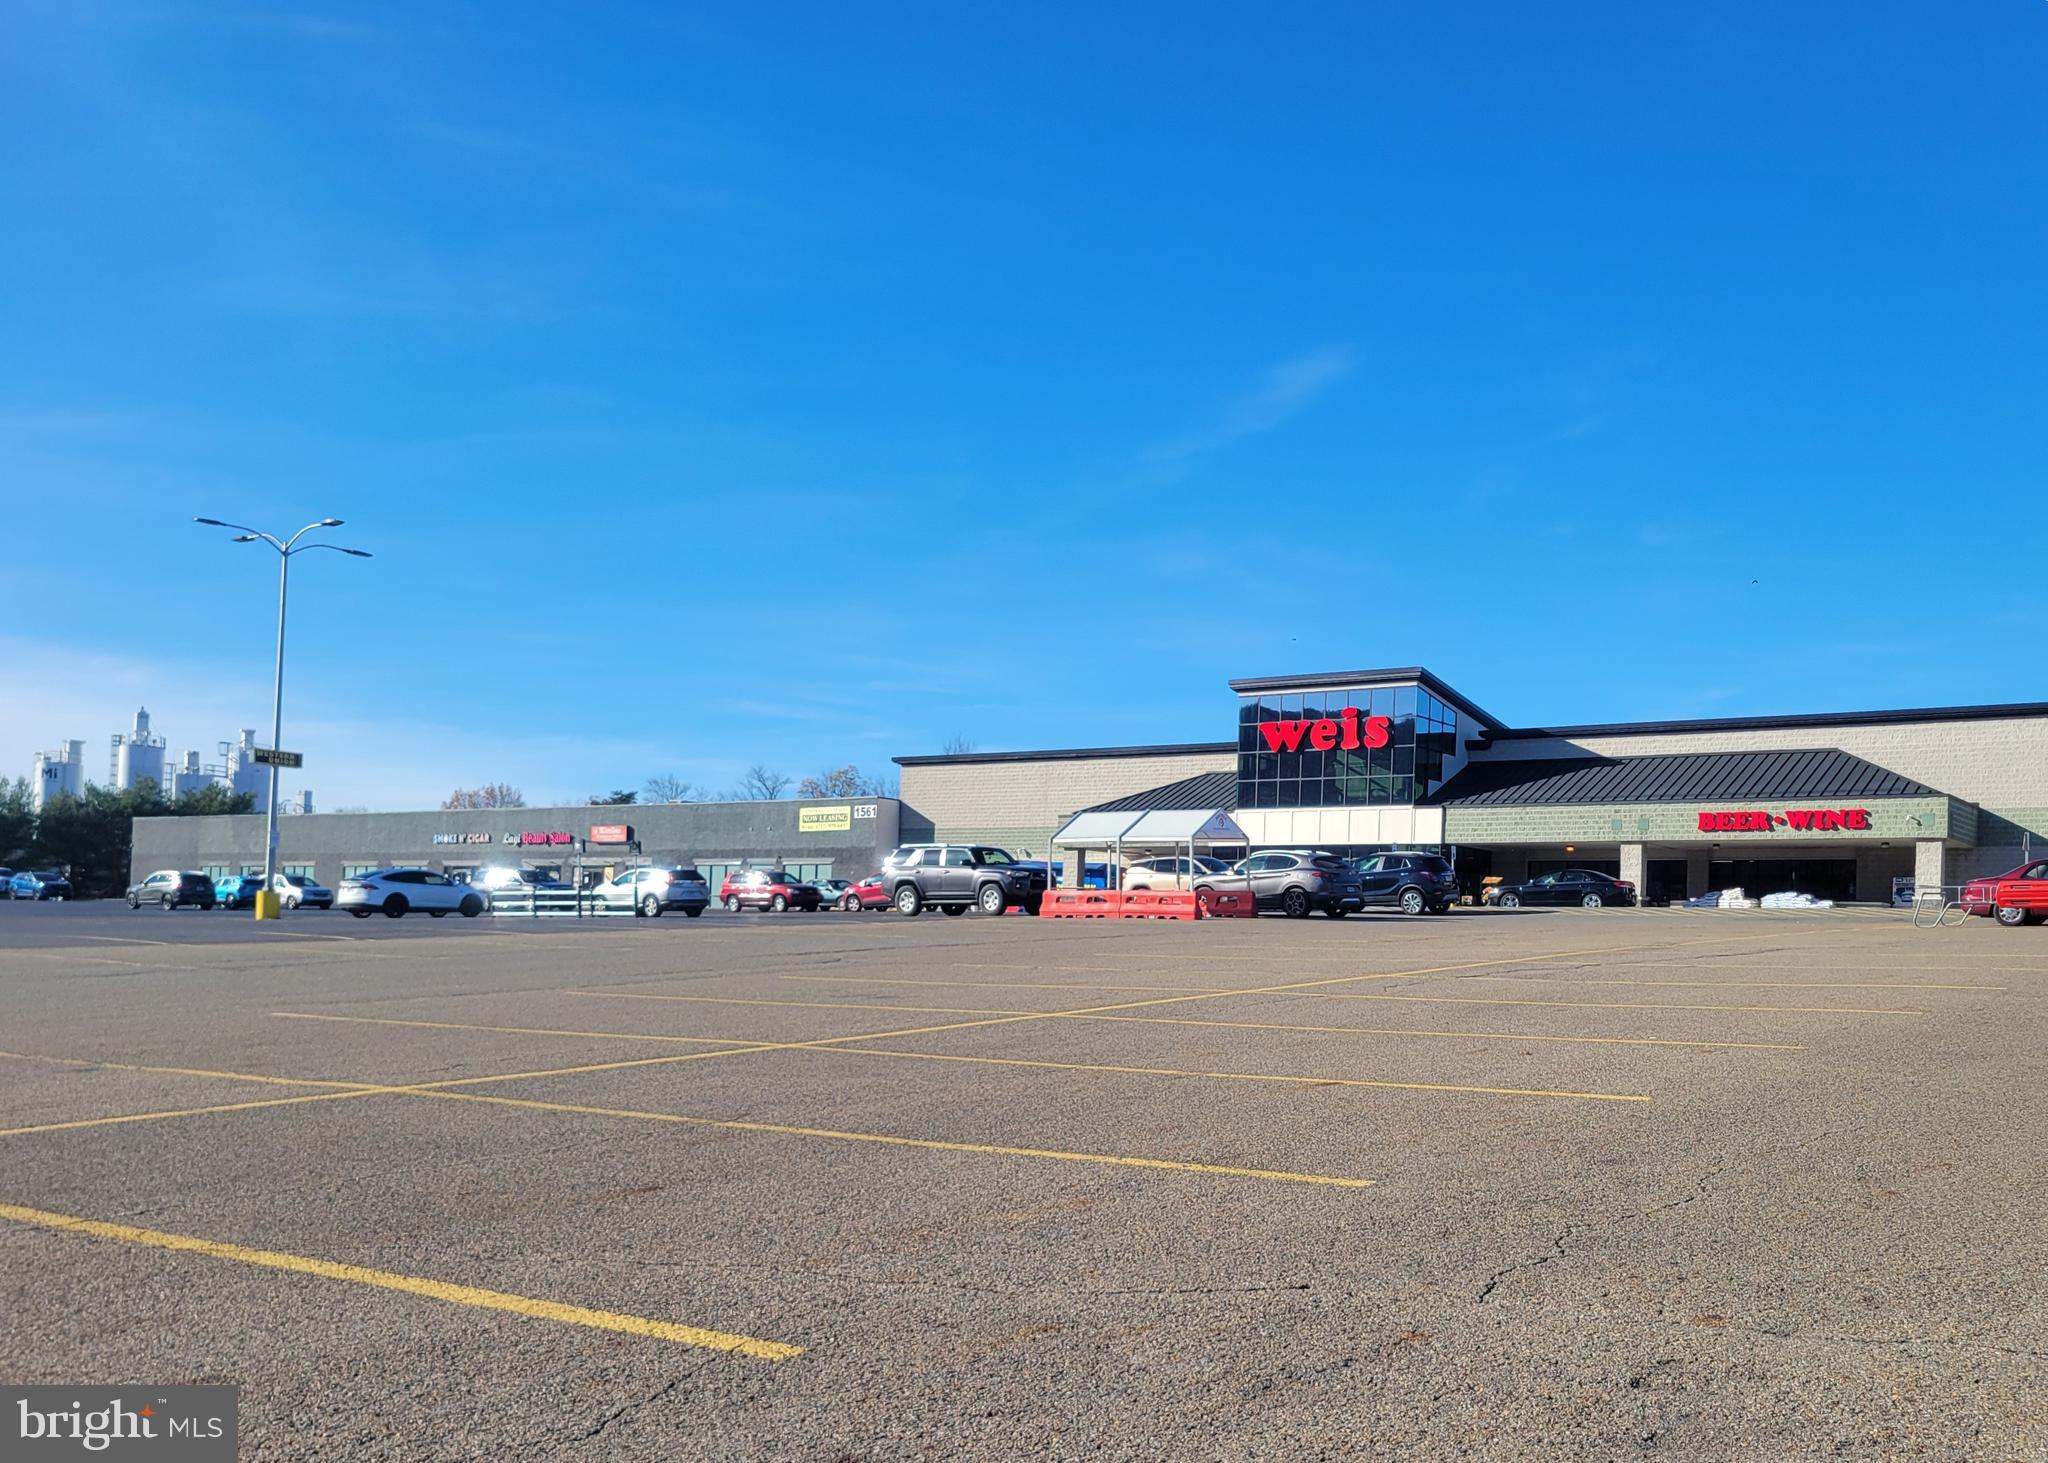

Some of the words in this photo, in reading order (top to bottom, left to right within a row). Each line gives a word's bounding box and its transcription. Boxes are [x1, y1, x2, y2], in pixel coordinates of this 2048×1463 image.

[1259, 706, 1390, 753] weis
[256, 751, 295, 759] WESTERN
[268, 757, 295, 765] UNION
[855, 806, 877, 817] 1561
[819, 814, 847, 822] LEASING
[432, 833, 457, 844] SMOKE
[467, 832, 490, 844] CIGAR
[548, 831, 571, 844] Salon
